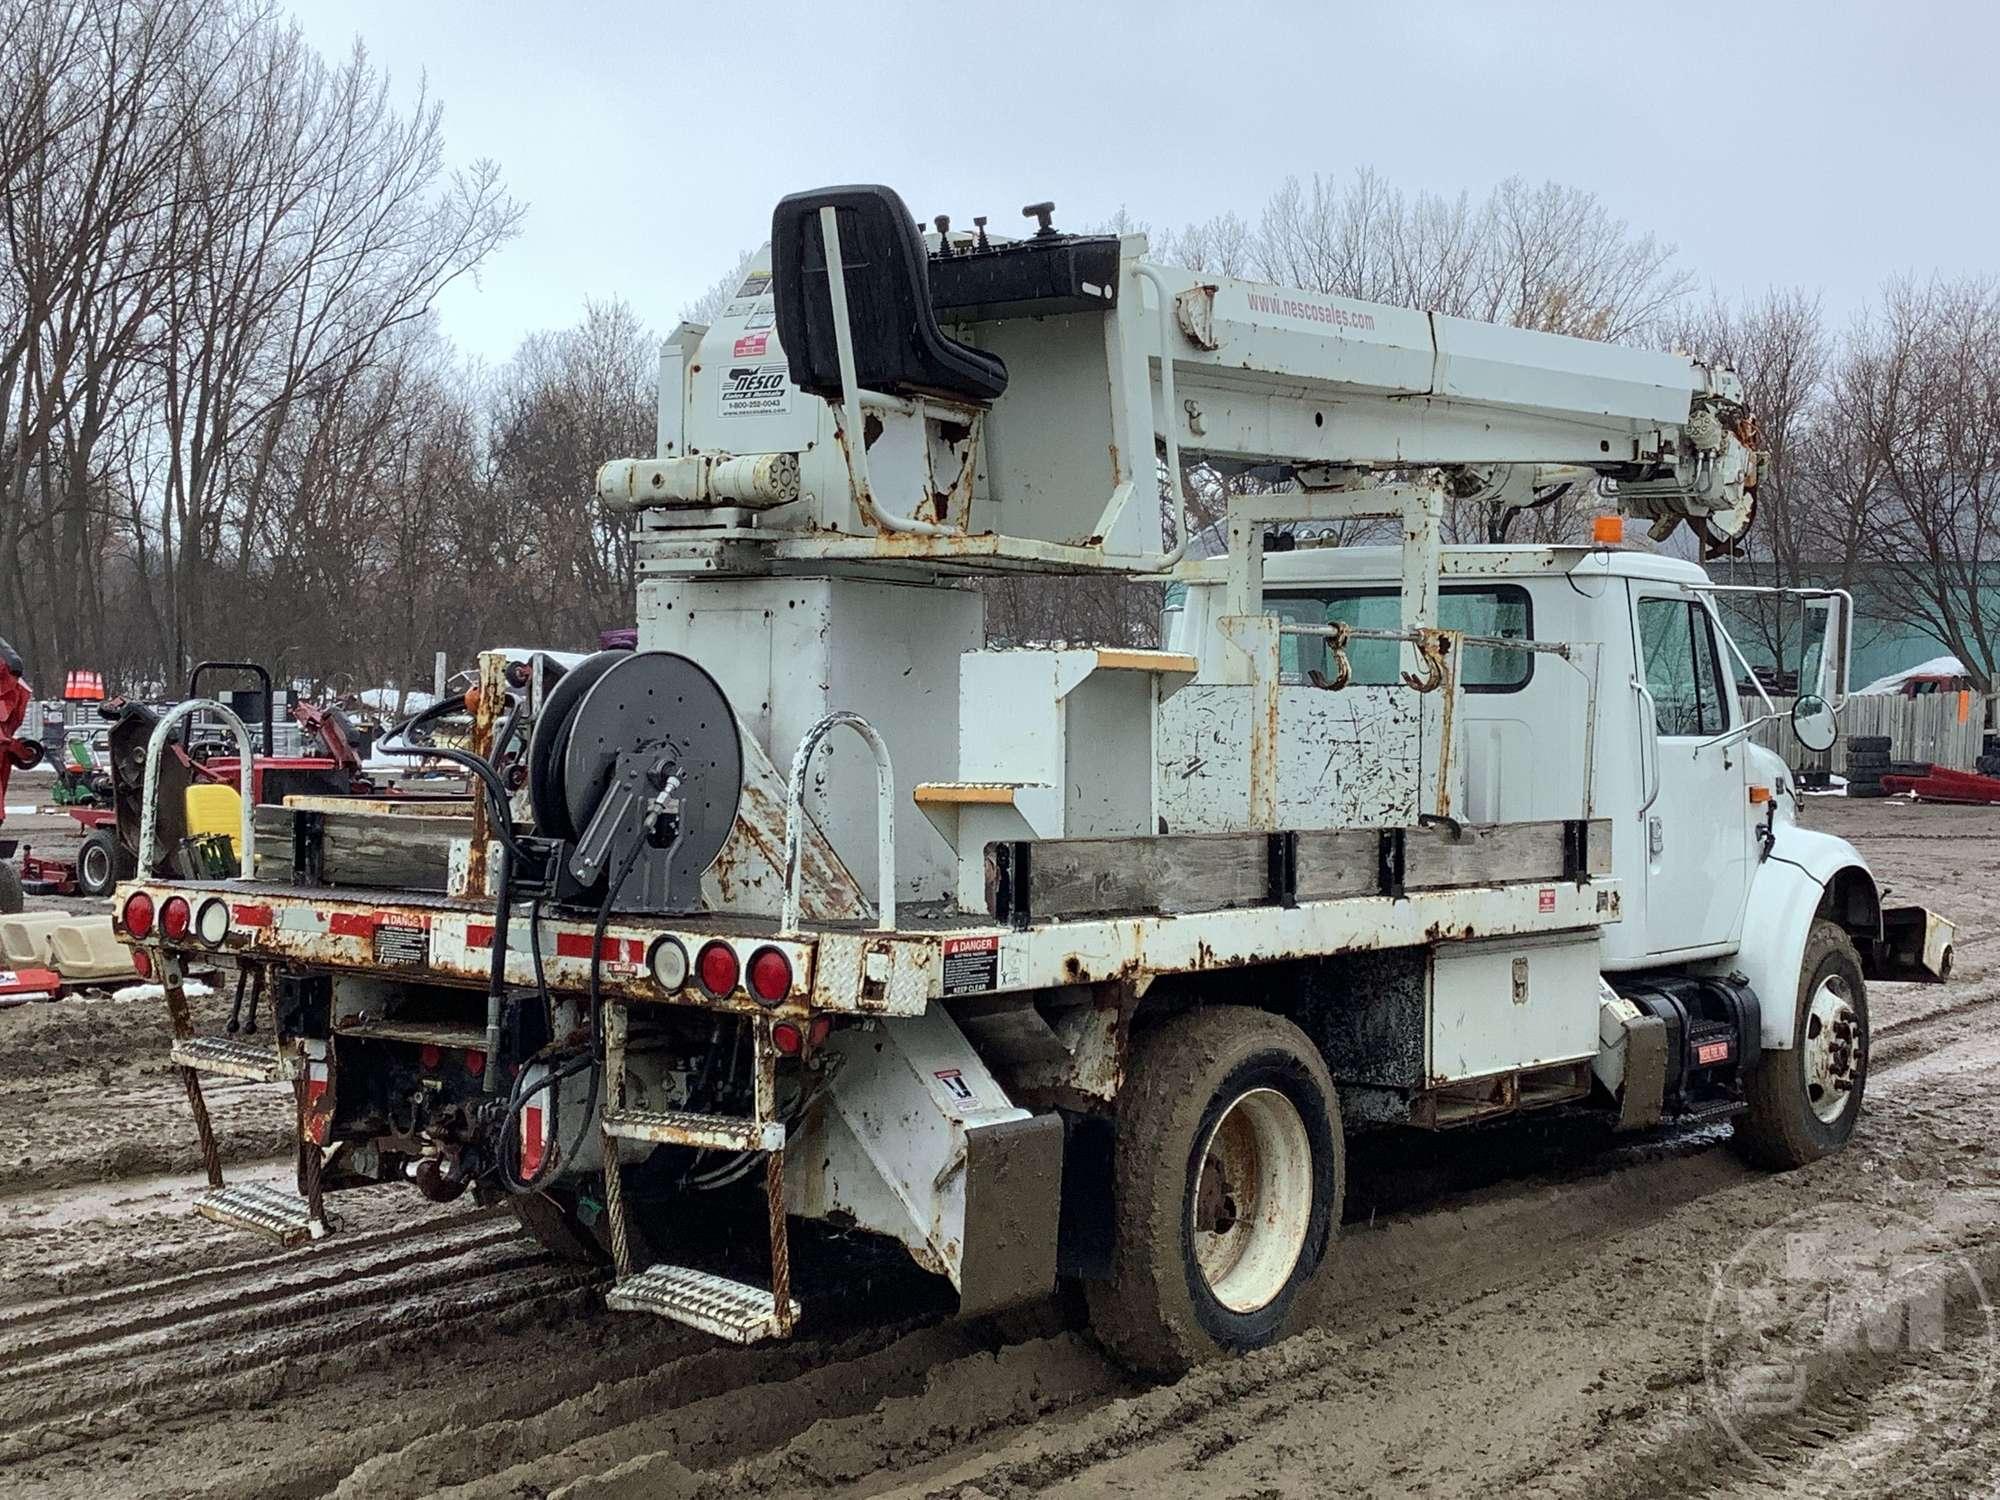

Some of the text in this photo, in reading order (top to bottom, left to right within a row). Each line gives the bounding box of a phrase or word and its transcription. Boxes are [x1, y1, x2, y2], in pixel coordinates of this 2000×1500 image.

[1247, 293, 1375, 331] www.nescosales.com
[735, 374, 784, 391] NESCO
[960, 939, 992, 952] DANGER
